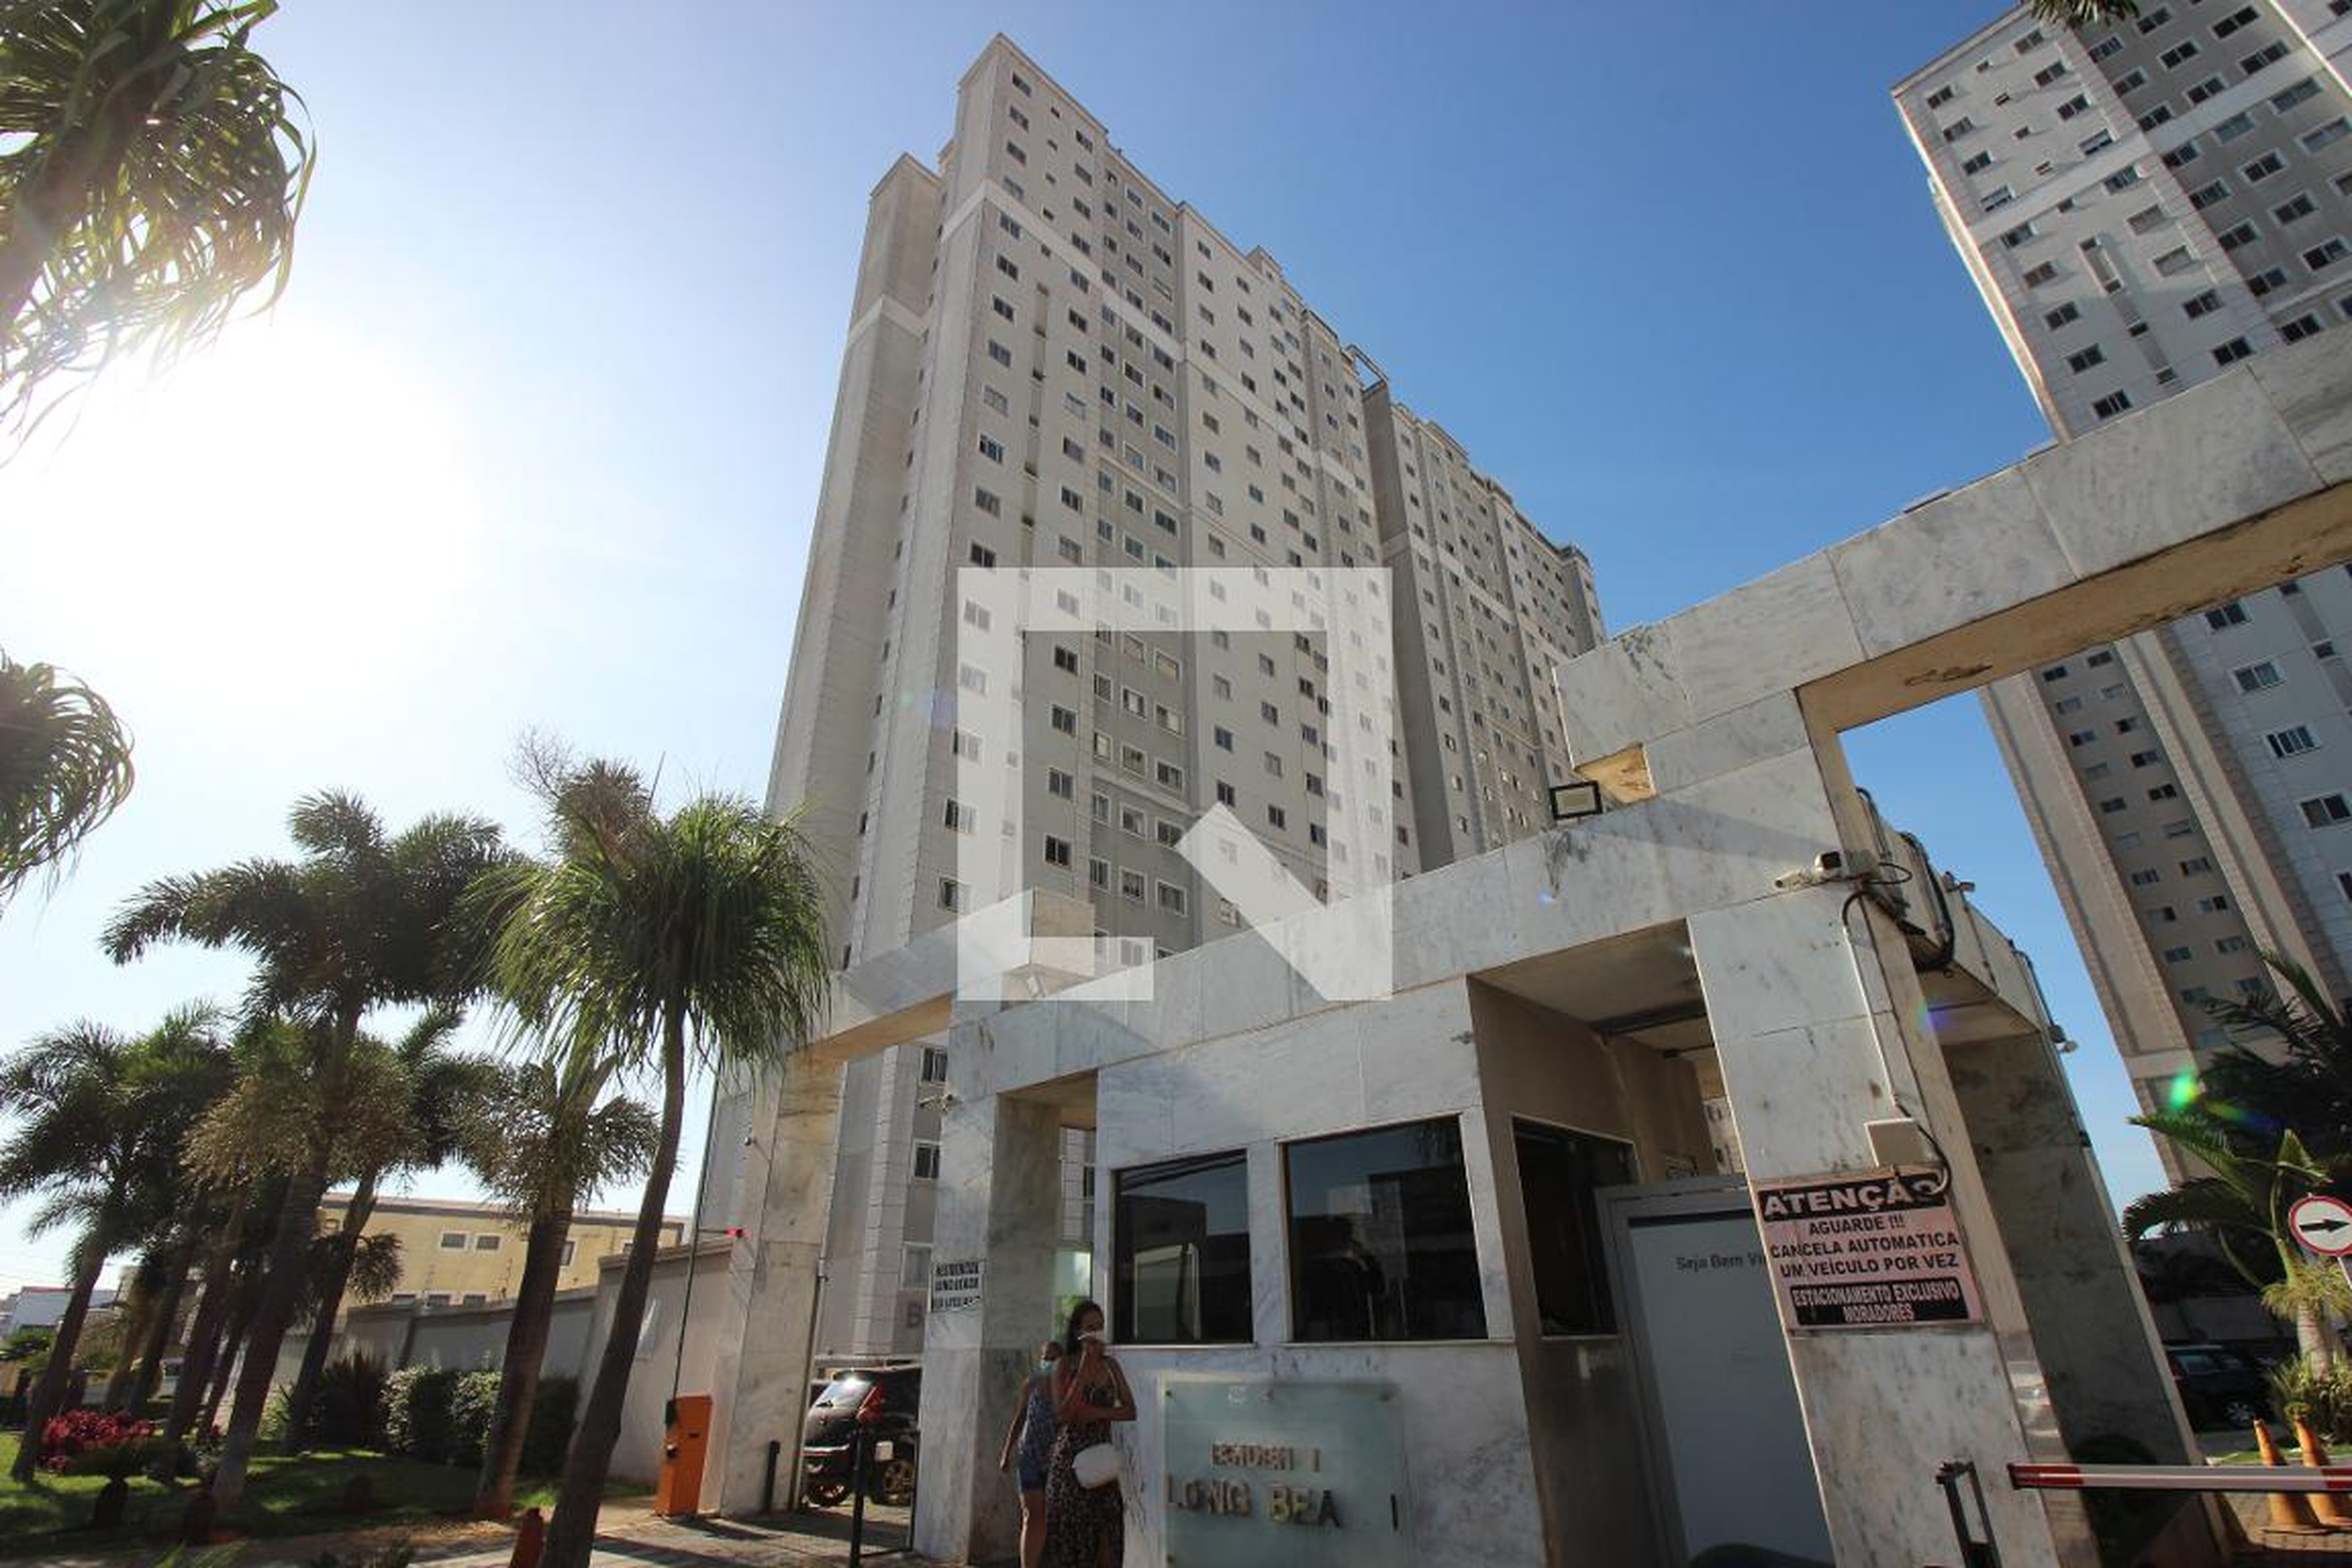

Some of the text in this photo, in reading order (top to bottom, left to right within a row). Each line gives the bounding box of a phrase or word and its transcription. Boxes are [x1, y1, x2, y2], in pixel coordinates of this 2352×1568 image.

[1809, 1217, 1885, 1236] AGUARDE
[1770, 1232, 1959, 1258] CANCELA AUTOMATICA
[1675, 1256, 1708, 1273] Seja
[1711, 1254, 1743, 1268] Bem
[1780, 1264, 1803, 1278] UM
[1885, 1256, 1920, 1272] POR
[1925, 1253, 1959, 1269] VEZ
[1792, 1280, 1961, 1306] ESTACIONAMENTO EXCLUSIVO
[1842, 1303, 1915, 1324] MORADORES
[1163, 1472, 1252, 1517] LONG
